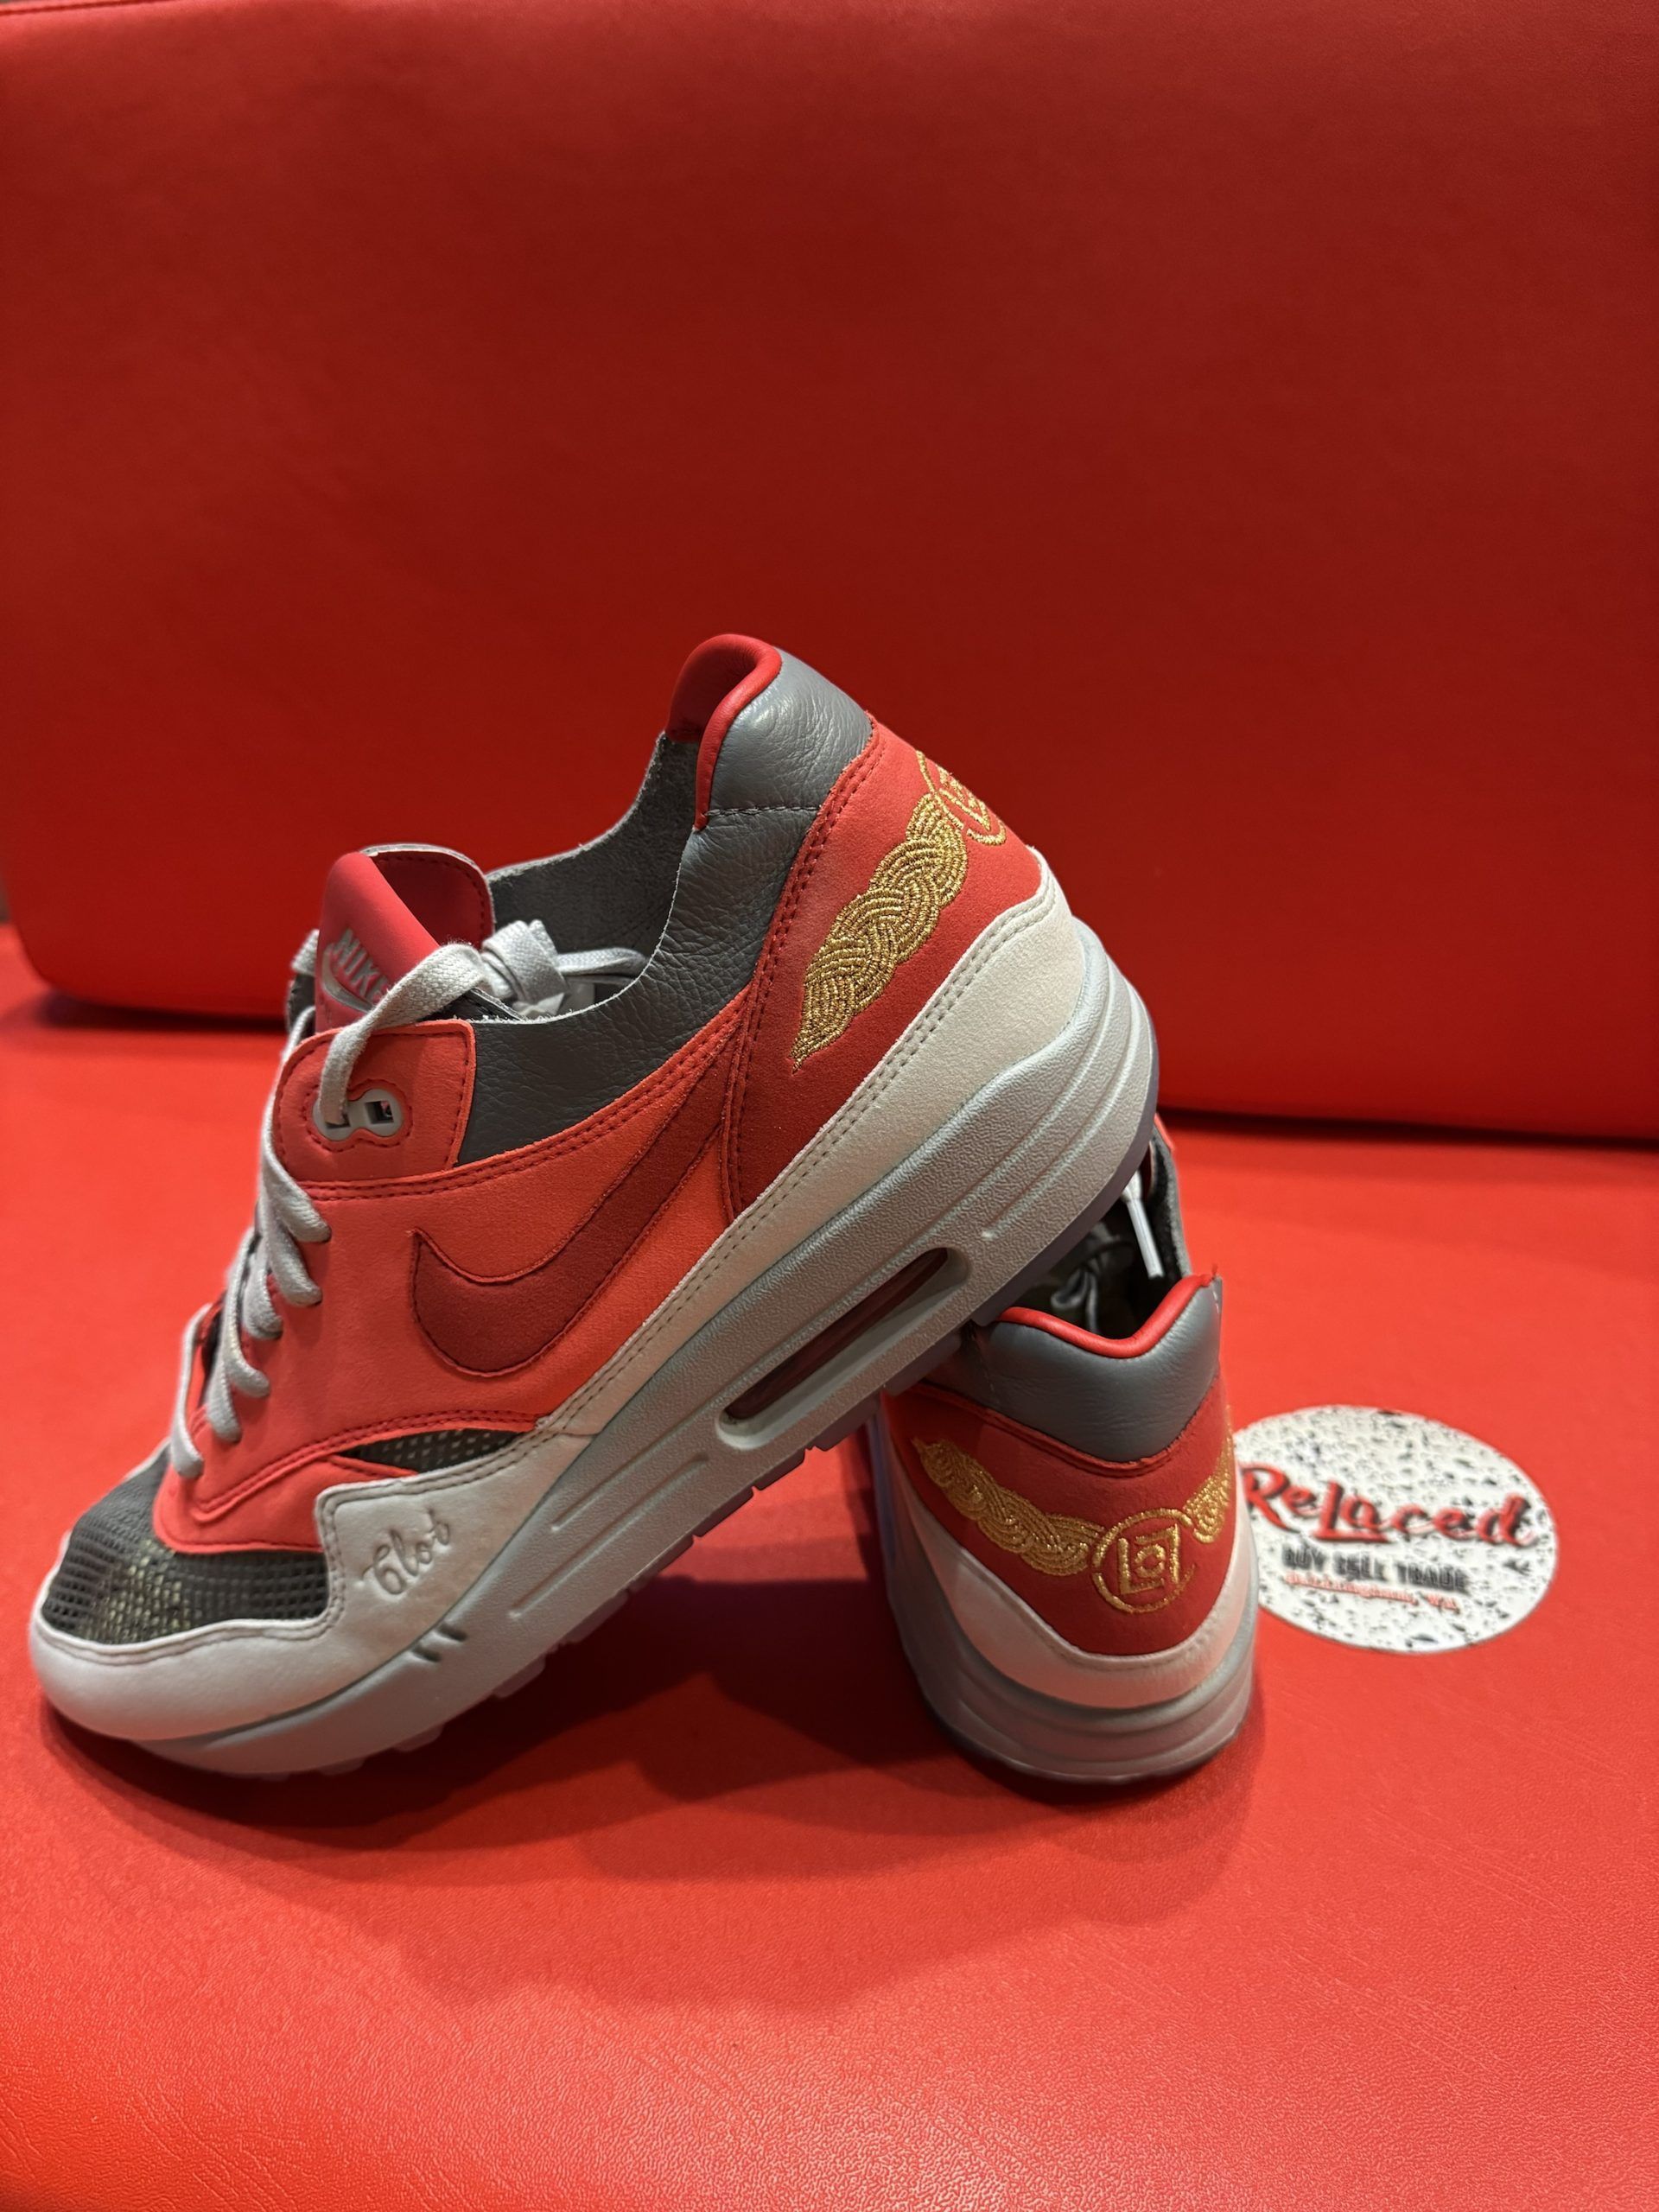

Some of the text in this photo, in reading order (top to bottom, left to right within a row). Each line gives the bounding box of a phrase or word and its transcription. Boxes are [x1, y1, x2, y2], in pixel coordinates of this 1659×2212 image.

[1282, 1544, 1327, 1572] BUY
[1332, 1551, 1387, 1582] SELL
[1395, 1559, 1469, 1594] TRADE
